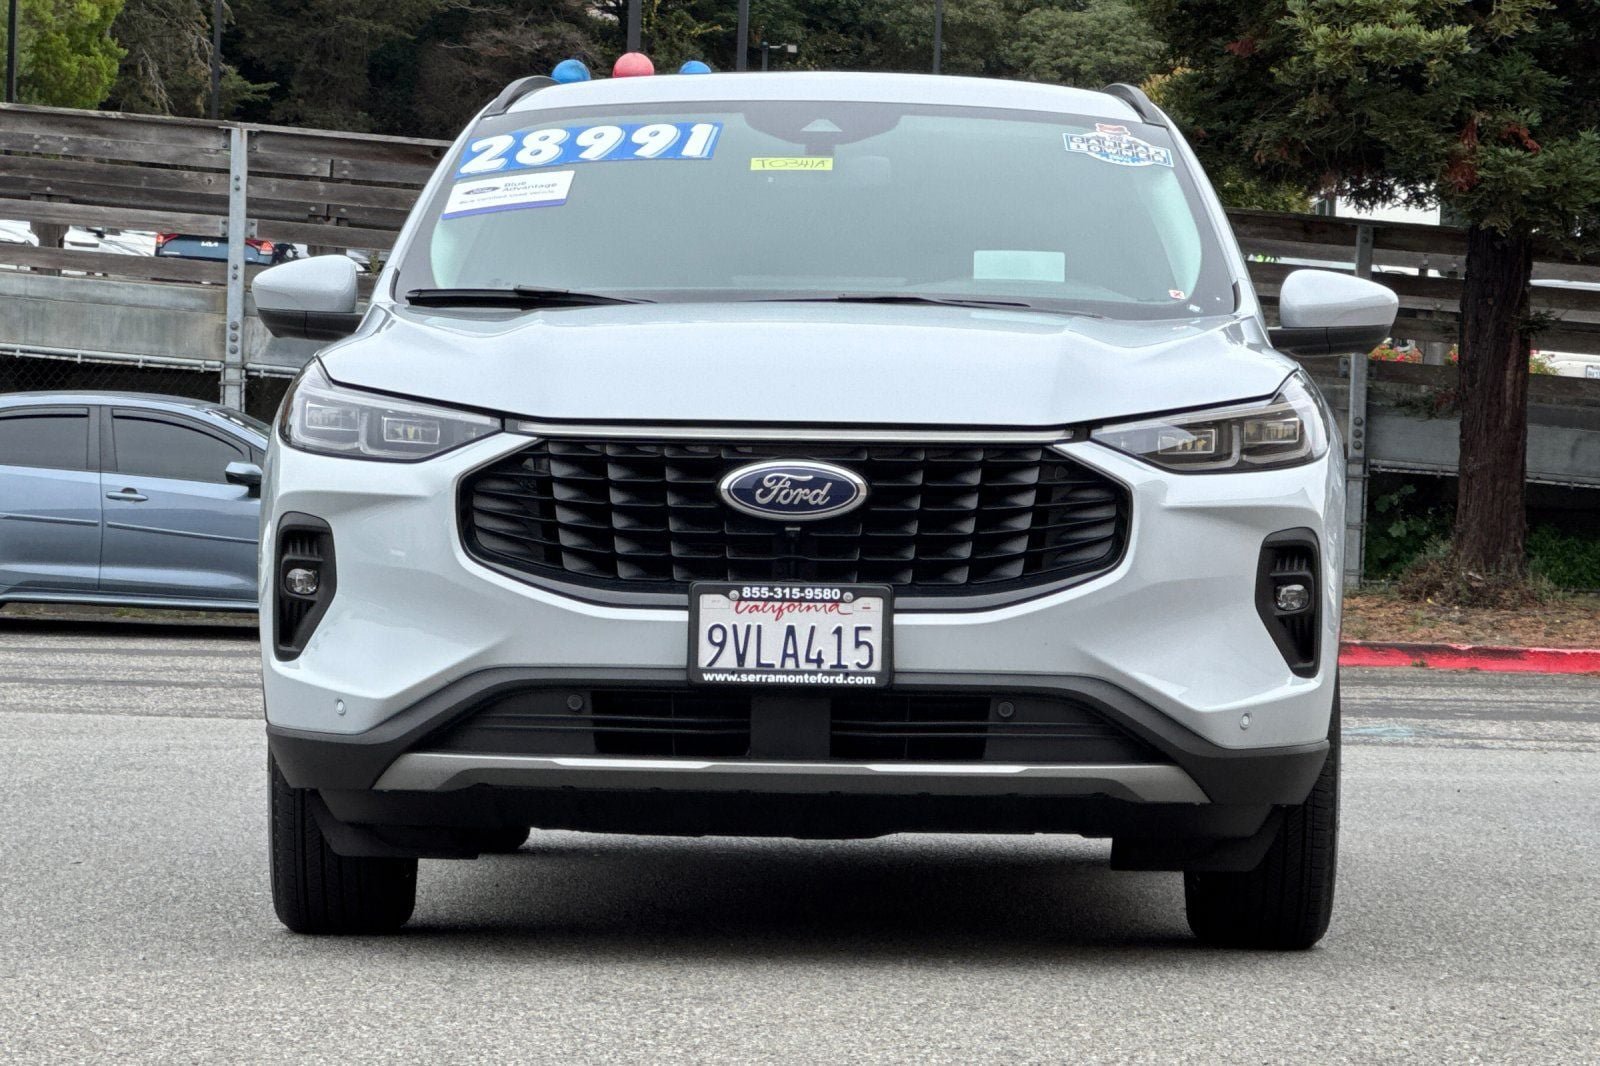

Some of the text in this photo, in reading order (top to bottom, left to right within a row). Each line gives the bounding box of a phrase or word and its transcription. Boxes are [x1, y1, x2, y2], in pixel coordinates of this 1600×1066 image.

[459, 123, 717, 174] 28991
[1071, 136, 1166, 156] CARFAX
[503, 183, 558, 192] Advantage
[755, 473, 832, 505] Ford
[742, 586, 841, 600] 855-315-9580
[734, 600, 853, 622] California
[706, 623, 874, 669] 9VLA415
[702, 672, 876, 685] www.serramonteford.com
